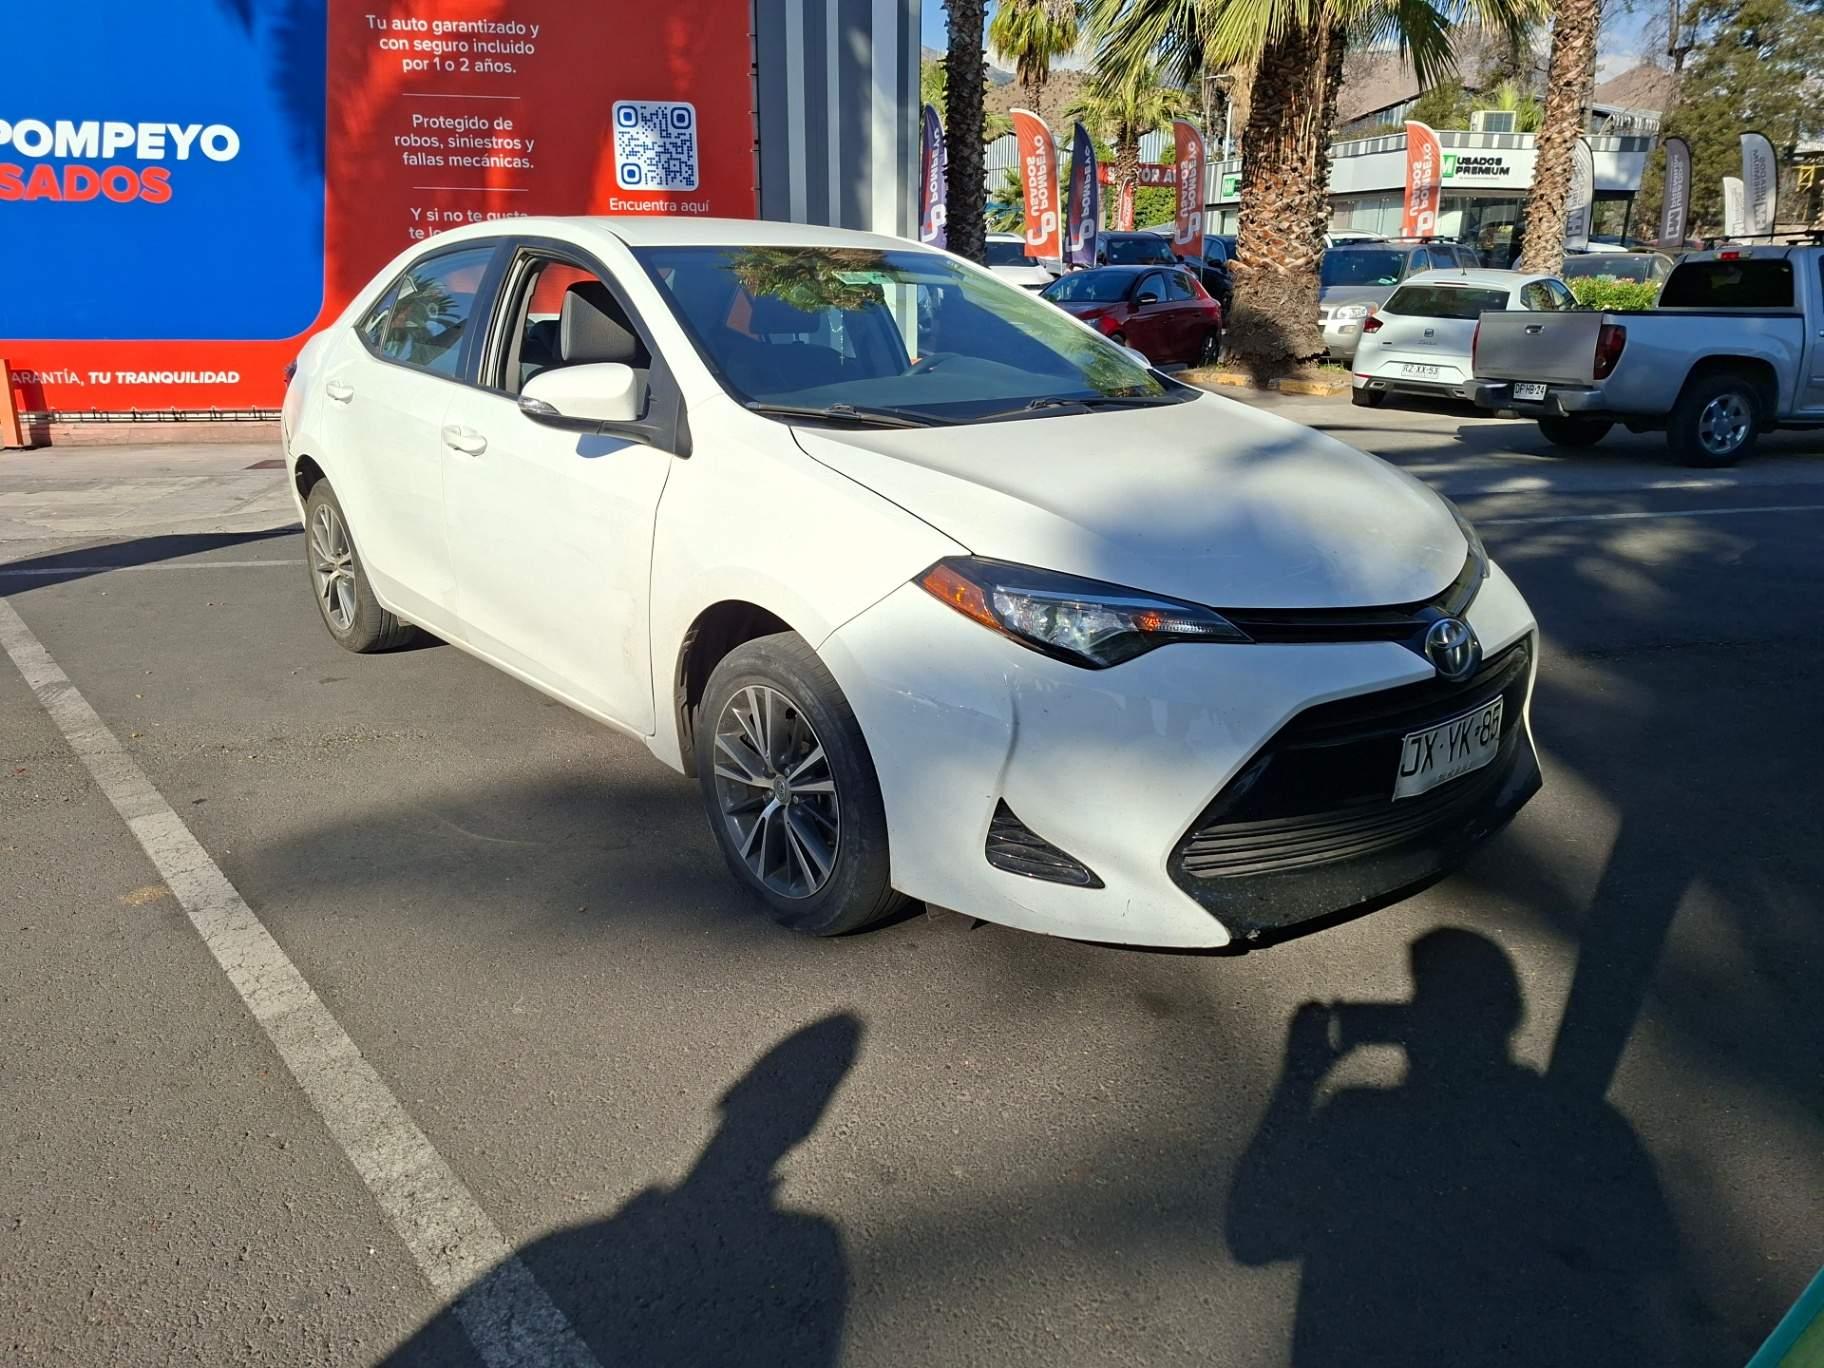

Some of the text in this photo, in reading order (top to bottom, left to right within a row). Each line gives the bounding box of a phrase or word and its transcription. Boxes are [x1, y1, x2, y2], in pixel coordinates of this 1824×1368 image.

[365, 14, 540, 38] Tu auto garantizado y
[379, 38, 535, 55] con seguro incluido
[402, 57, 517, 74] por 1 o 2 años.
[412, 114, 513, 132] Protegido de
[394, 133, 535, 152] robos, siniestros y
[402, 152, 535, 168] fallas mecánicas.
[1455, 166, 1511, 176] PREMIUM
[609, 197, 710, 214] Encuentra aquí
[410, 207, 422, 221] Y
[426, 207, 439, 221] si
[443, 211, 464, 222] no
[466, 209, 482, 222] te
[408, 226, 425, 239] te
[87, 371, 112, 385] TU
[116, 371, 240, 385] TRANQUILIDAD
